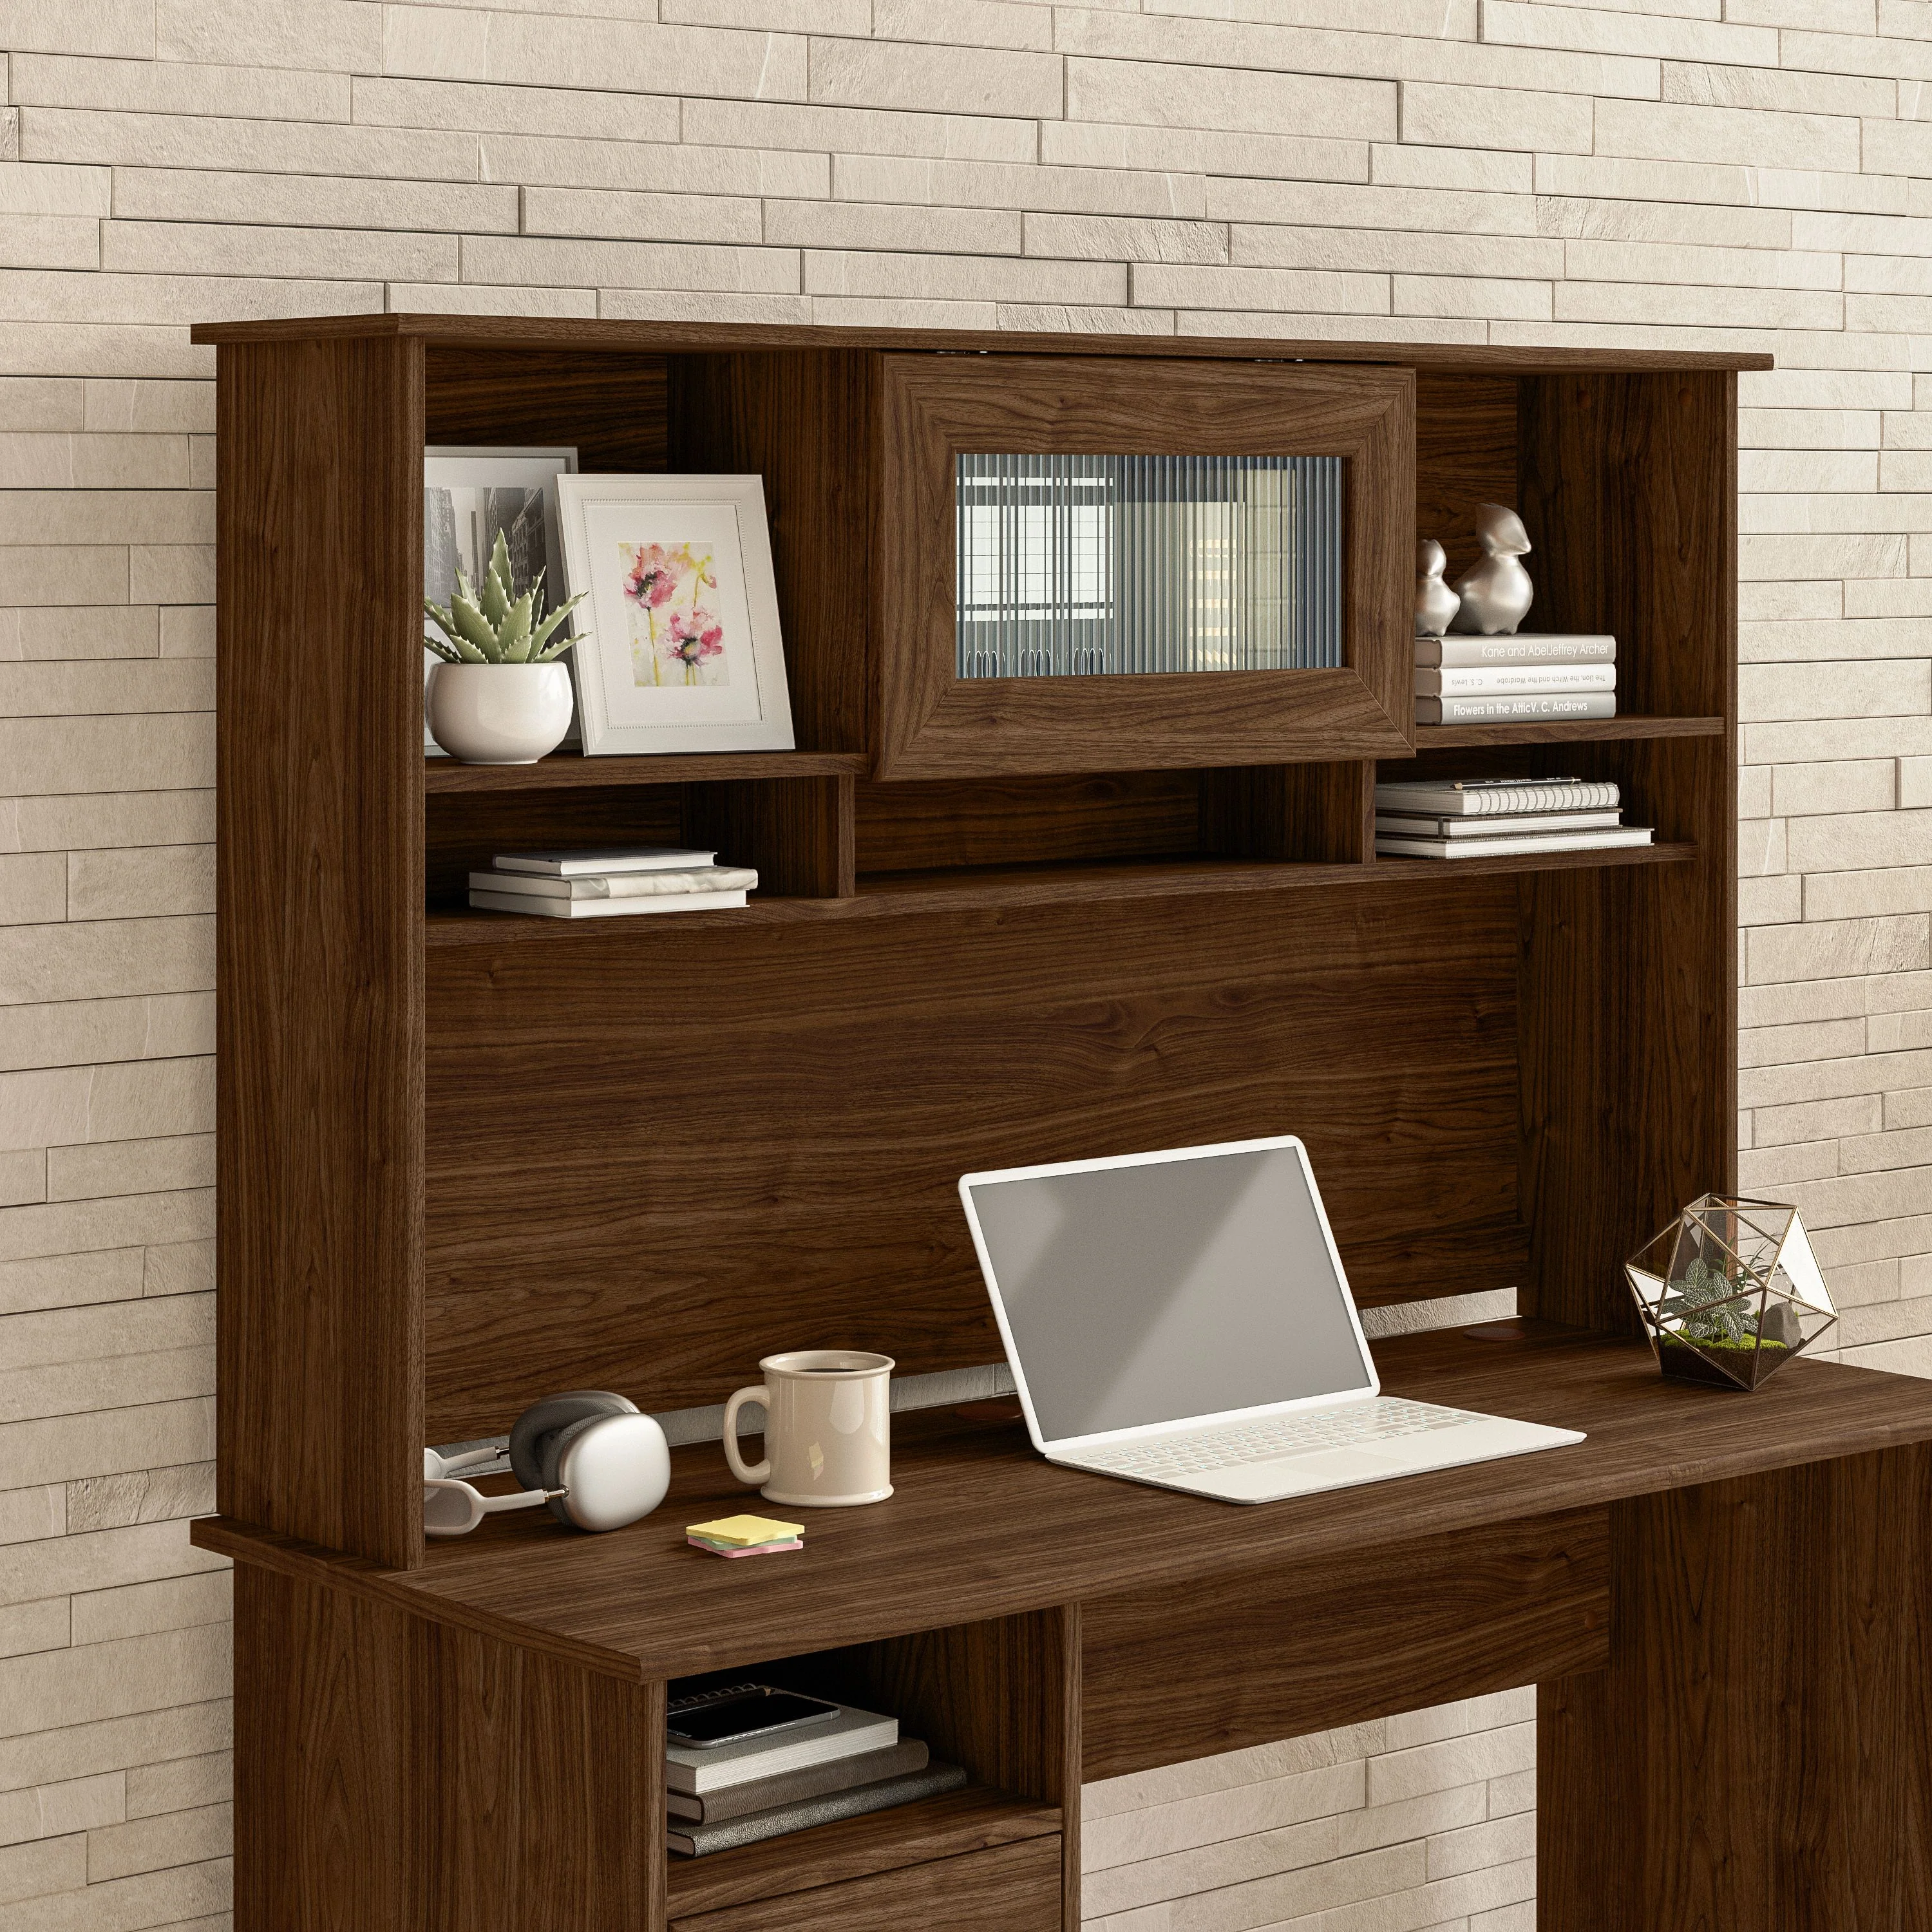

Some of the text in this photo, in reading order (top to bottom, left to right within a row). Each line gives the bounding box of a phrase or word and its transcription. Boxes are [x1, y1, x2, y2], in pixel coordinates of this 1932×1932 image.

[1482, 646, 1505, 658] Kane
[1508, 645, 1525, 657] and
[1579, 643, 1609, 655] Archer
[1454, 705, 1484, 716] Flowers
[1487, 703, 1494, 714] in
[1497, 703, 1510, 714] the
[1541, 701, 1550, 712] C.
[1553, 701, 1587, 712] Andrews
